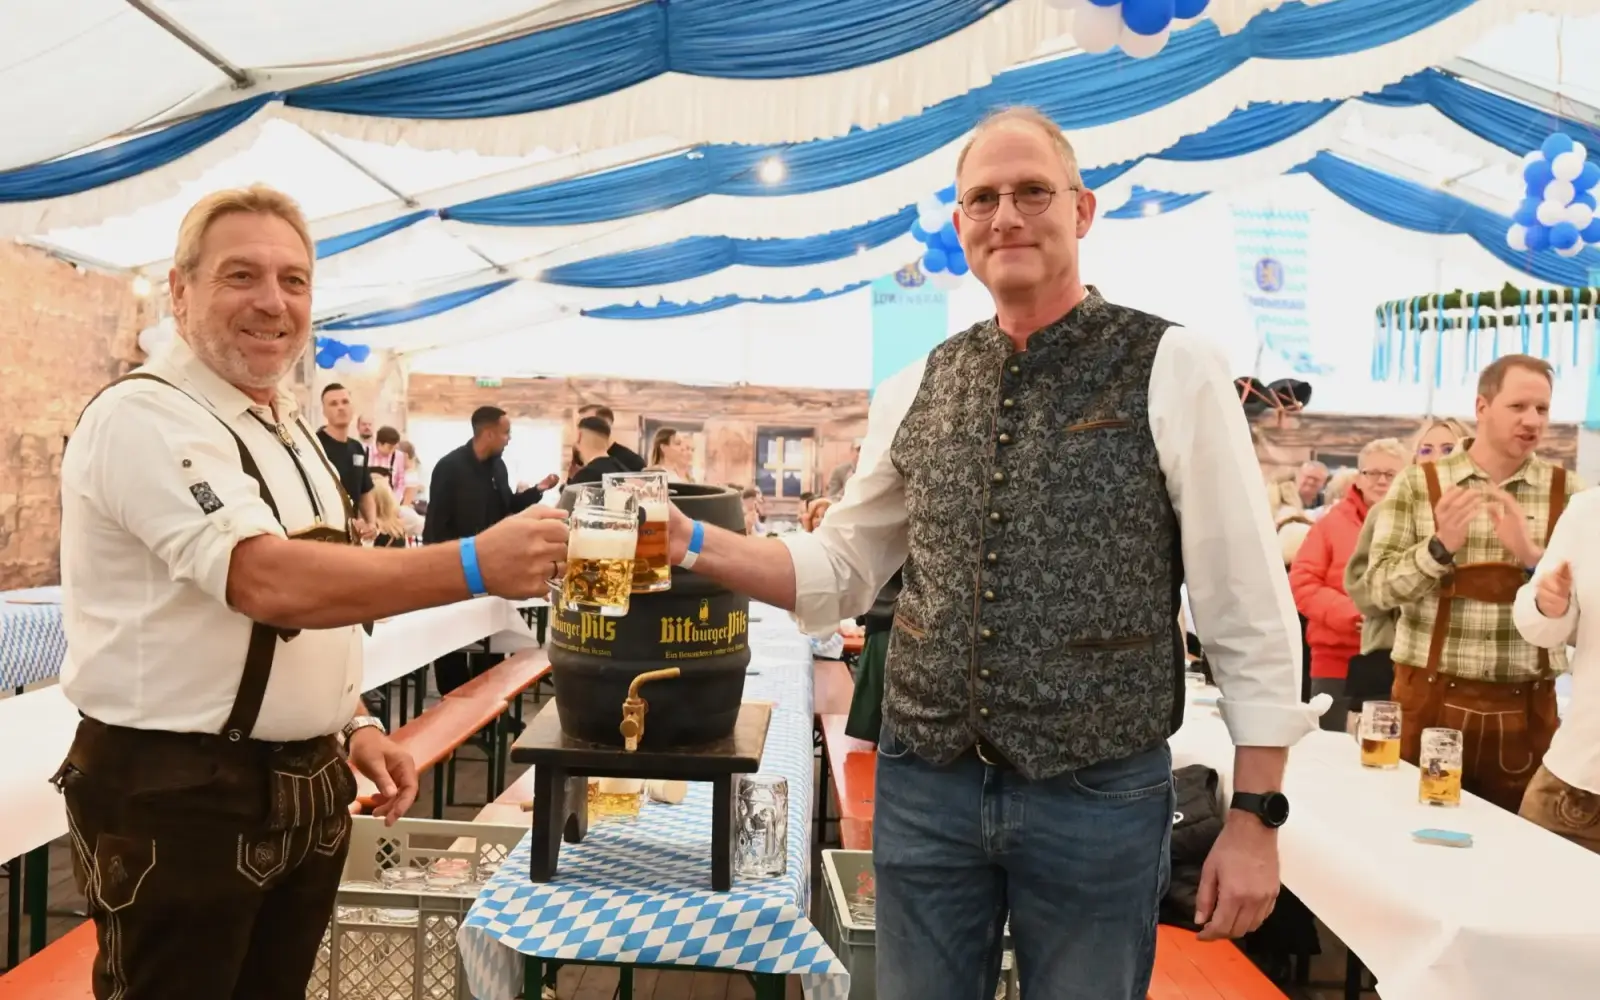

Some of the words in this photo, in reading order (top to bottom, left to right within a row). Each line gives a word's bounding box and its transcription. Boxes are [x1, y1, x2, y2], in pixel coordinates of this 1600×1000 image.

[581, 612, 616, 644] Pils
[660, 616, 729, 645] Bitburger
[728, 610, 746, 644] Pils
